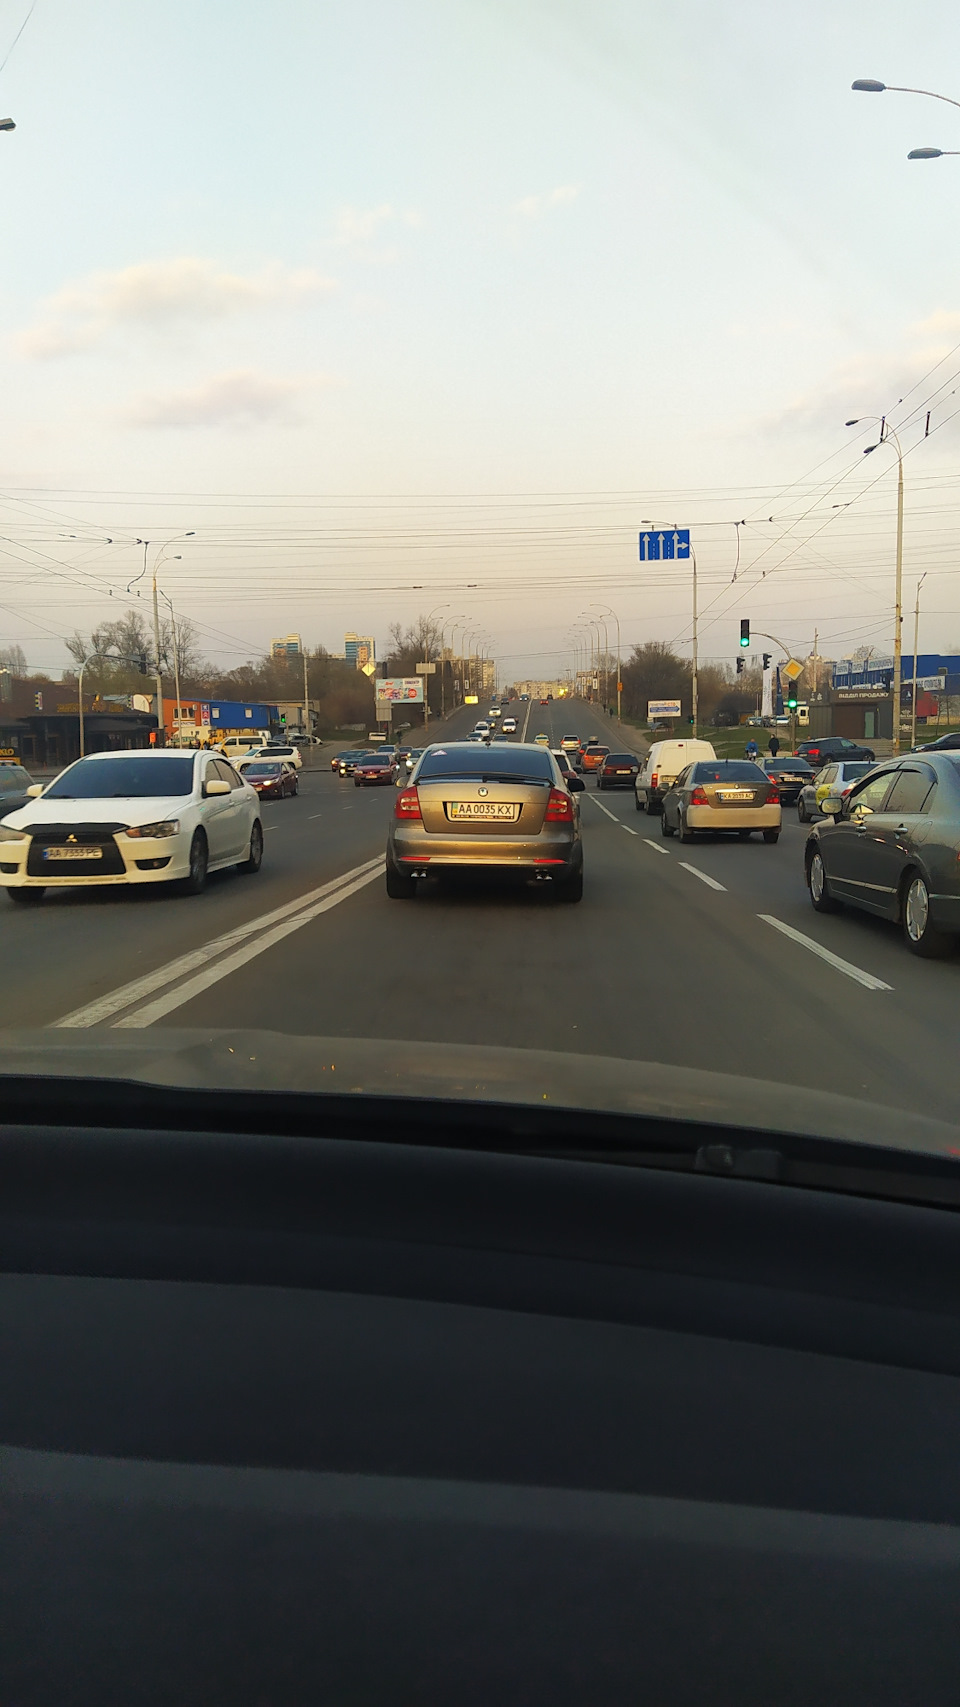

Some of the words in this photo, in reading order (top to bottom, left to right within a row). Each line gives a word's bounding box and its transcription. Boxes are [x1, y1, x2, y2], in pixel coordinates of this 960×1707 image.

[458, 804, 472, 814] AA
[473, 804, 496, 815] 0035
[497, 805, 512, 815] KX
